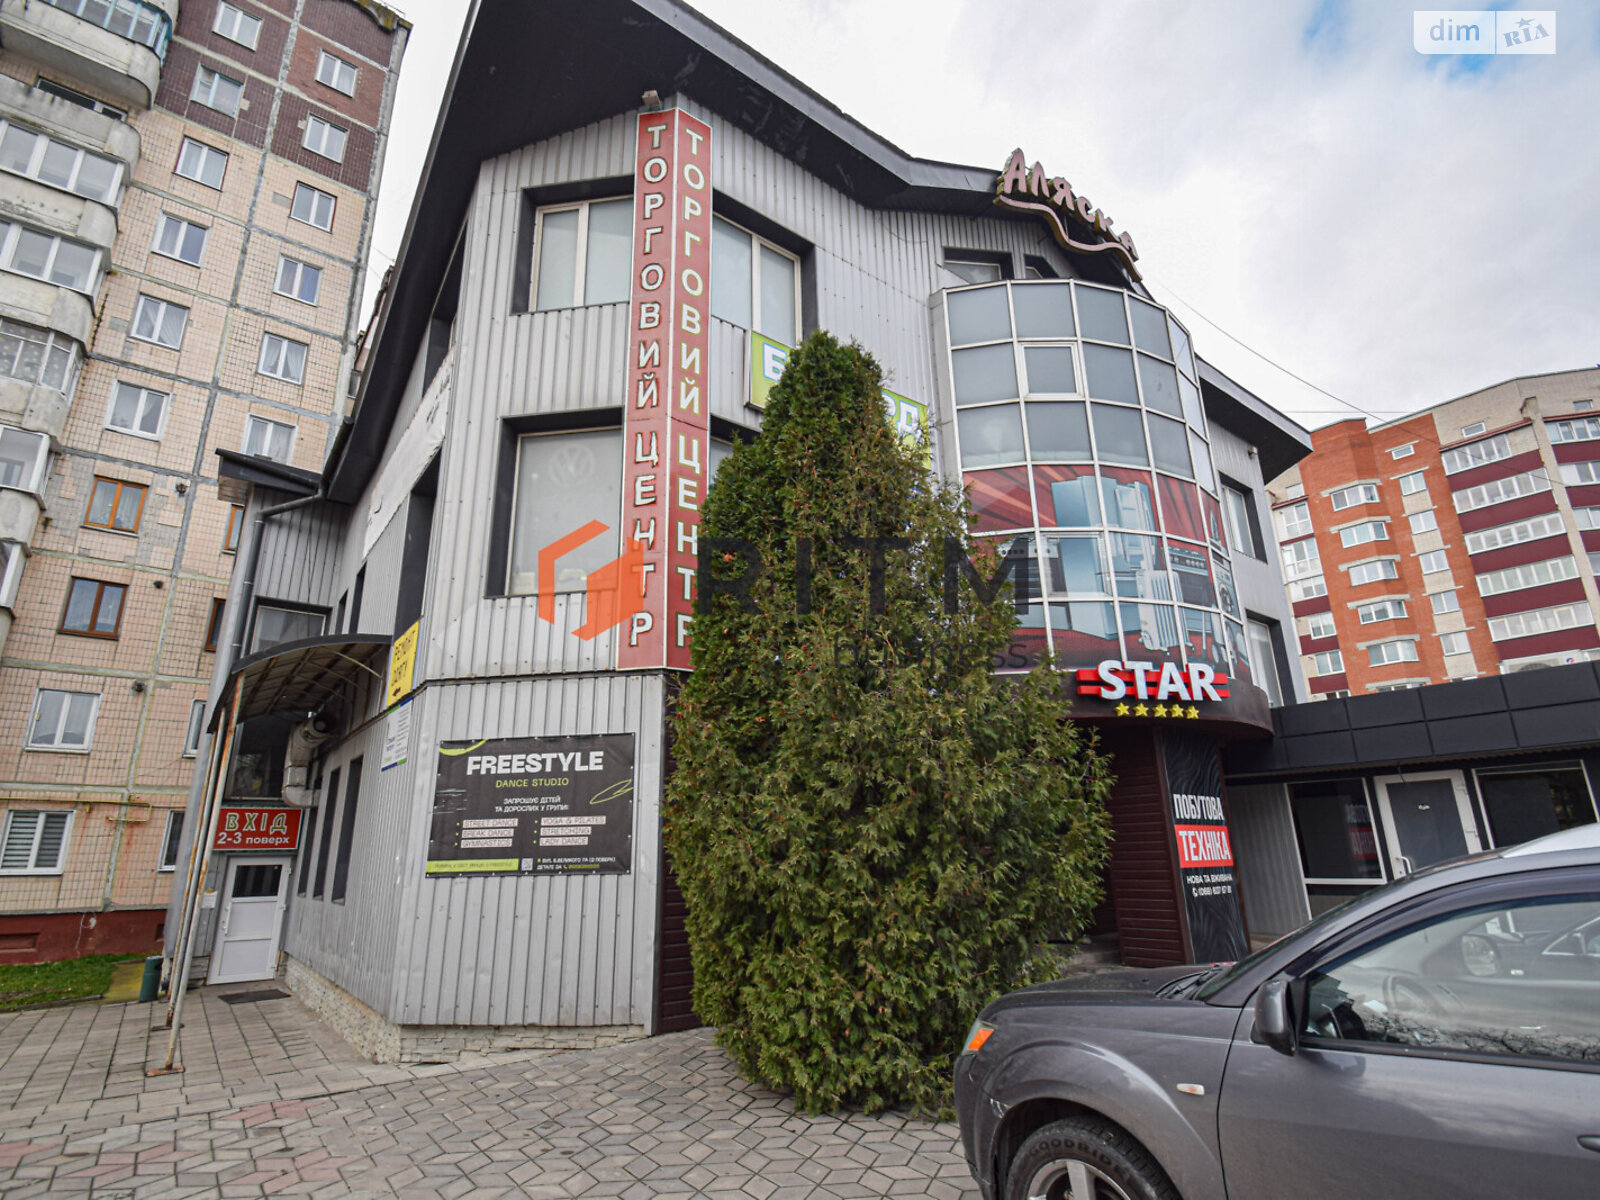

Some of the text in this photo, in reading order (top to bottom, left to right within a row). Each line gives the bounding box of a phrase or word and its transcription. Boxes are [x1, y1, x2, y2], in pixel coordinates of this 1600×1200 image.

[637, 124, 668, 409] ТОРГОВИЙ
[679, 127, 705, 414] ТОРГОВИЙ
[628, 431, 659, 648] ЦЕНТР
[1097, 660, 1222, 702] STAR
[466, 751, 604, 775] FREESTYLE
[495, 777, 569, 788] DANCE STUDIO
[1173, 794, 1225, 820] ПОБУТОВА
[225, 812, 288, 836] ВХІД
[217, 832, 289, 846] 2-3 поверх
[1179, 830, 1232, 862] ТЕХНІКА
